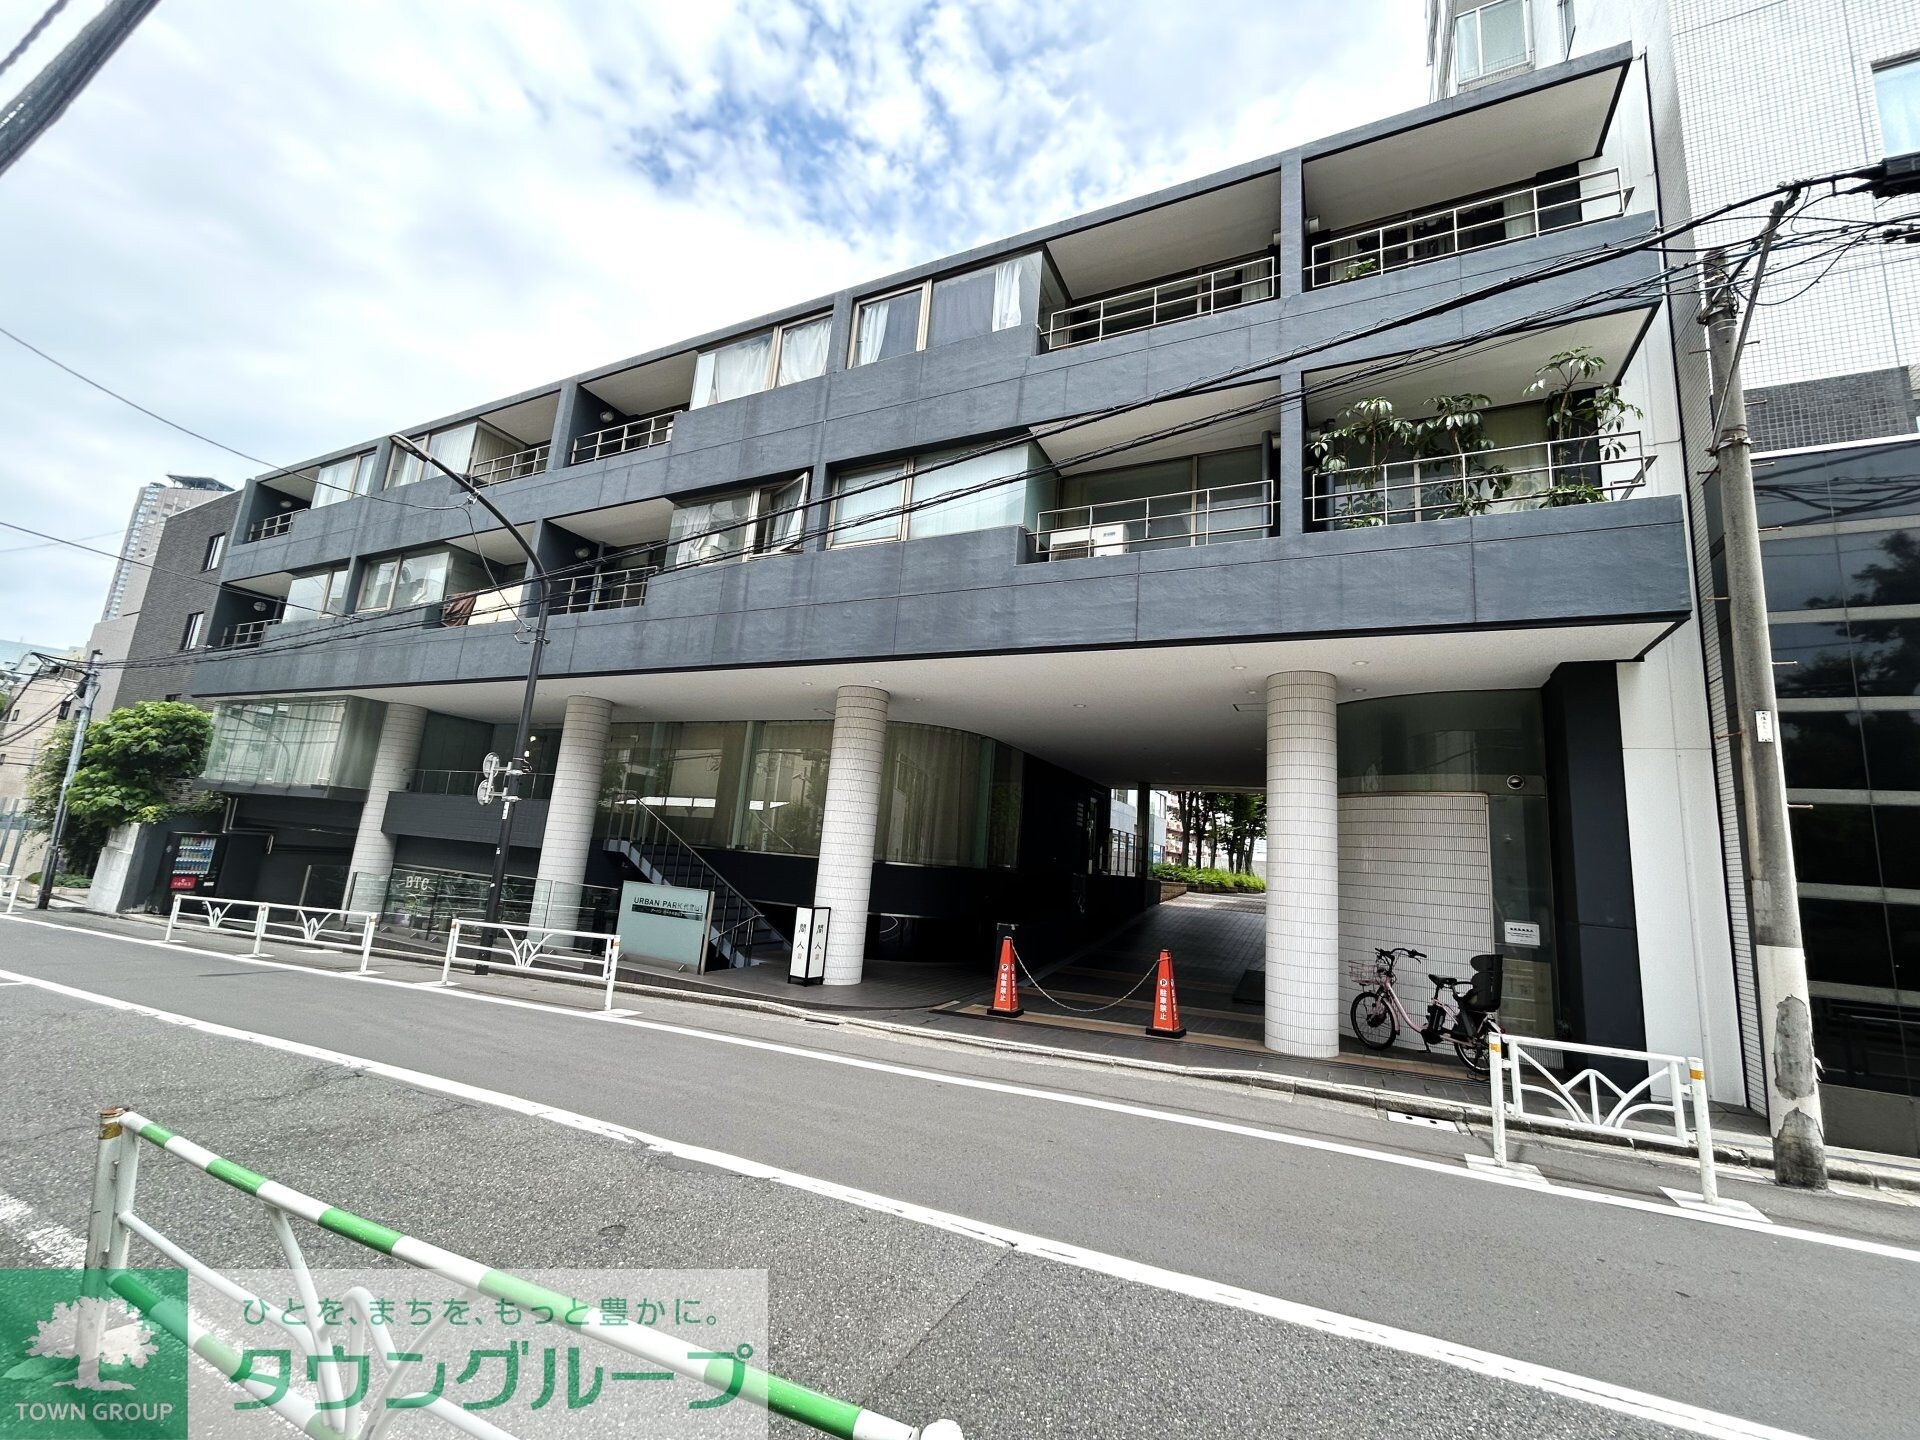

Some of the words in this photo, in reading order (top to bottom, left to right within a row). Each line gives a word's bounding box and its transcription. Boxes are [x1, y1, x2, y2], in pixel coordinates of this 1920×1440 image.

[405, 876, 430, 890] BTC
[633, 897, 660, 906] URBAN
[662, 900, 684, 910] PARK
